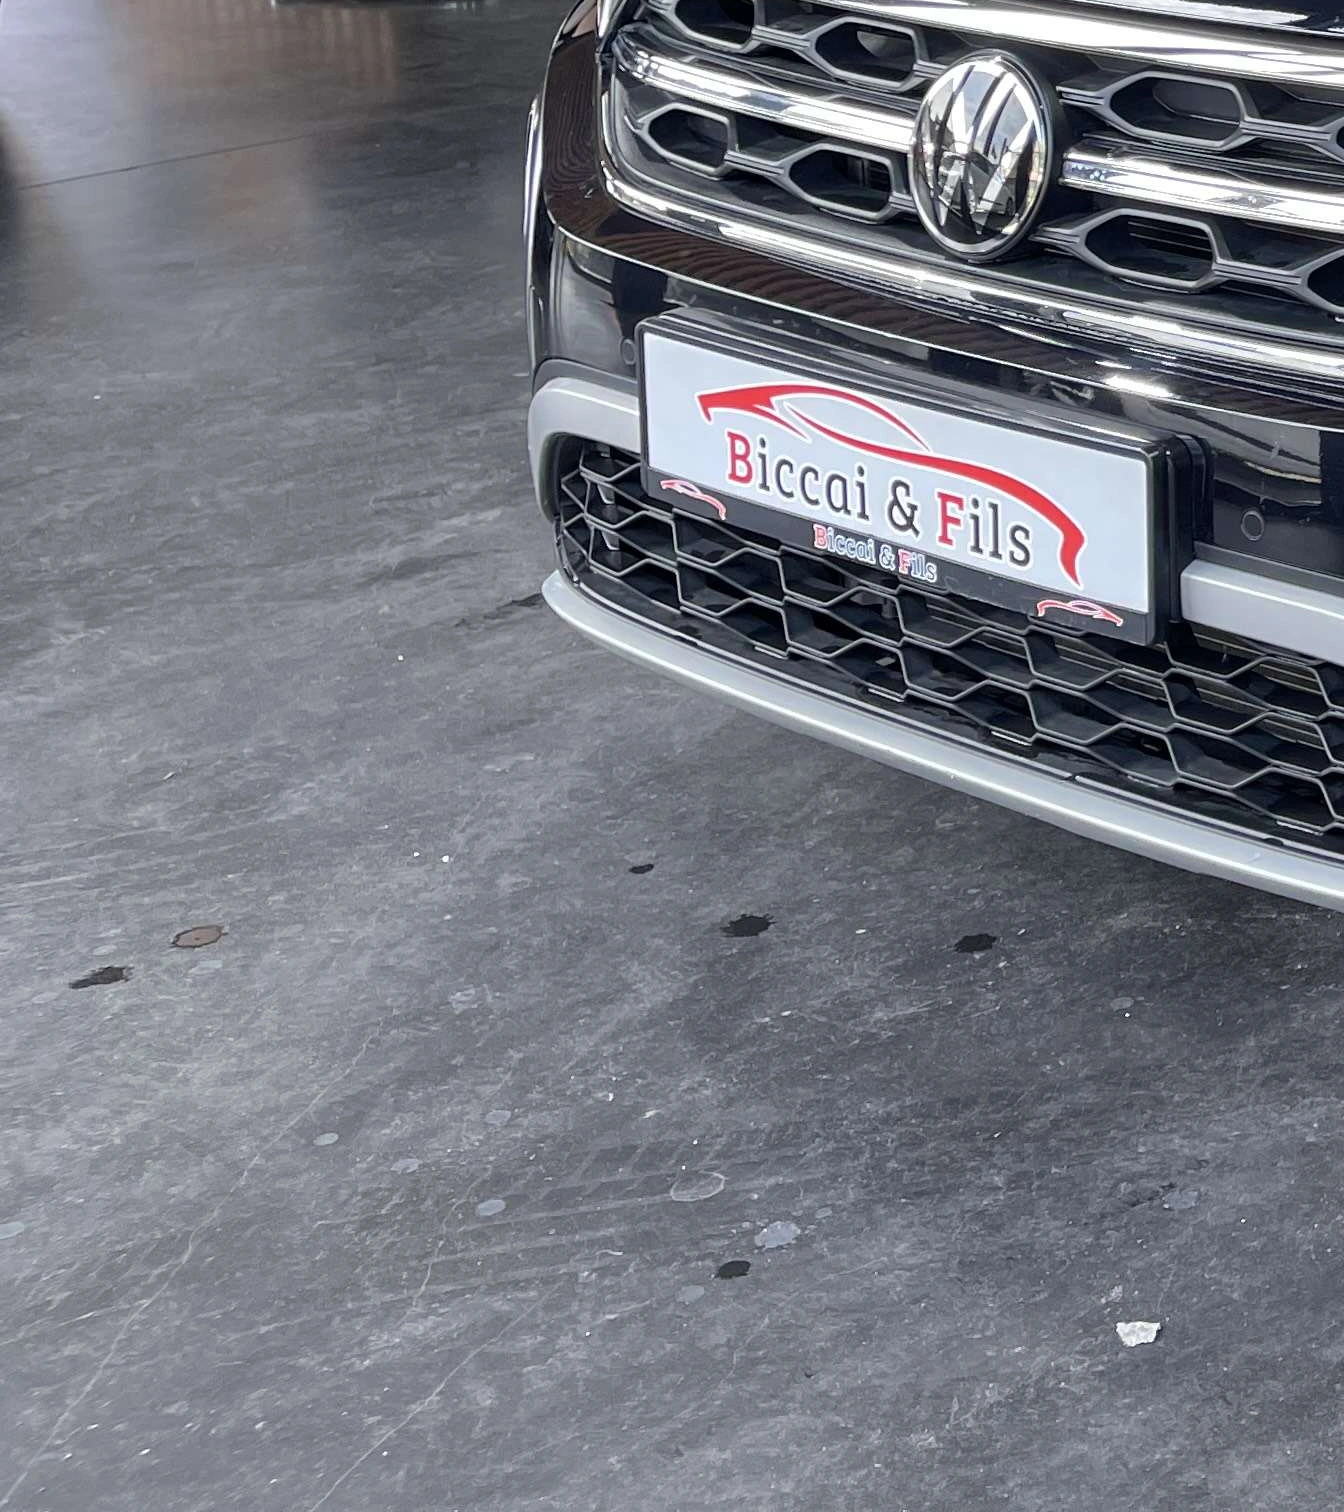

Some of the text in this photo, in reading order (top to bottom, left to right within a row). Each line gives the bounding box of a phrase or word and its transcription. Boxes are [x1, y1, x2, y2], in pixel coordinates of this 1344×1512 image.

[726, 432, 1031, 568] Biccai & Fils
[813, 523, 938, 582] Biccai & Fils
